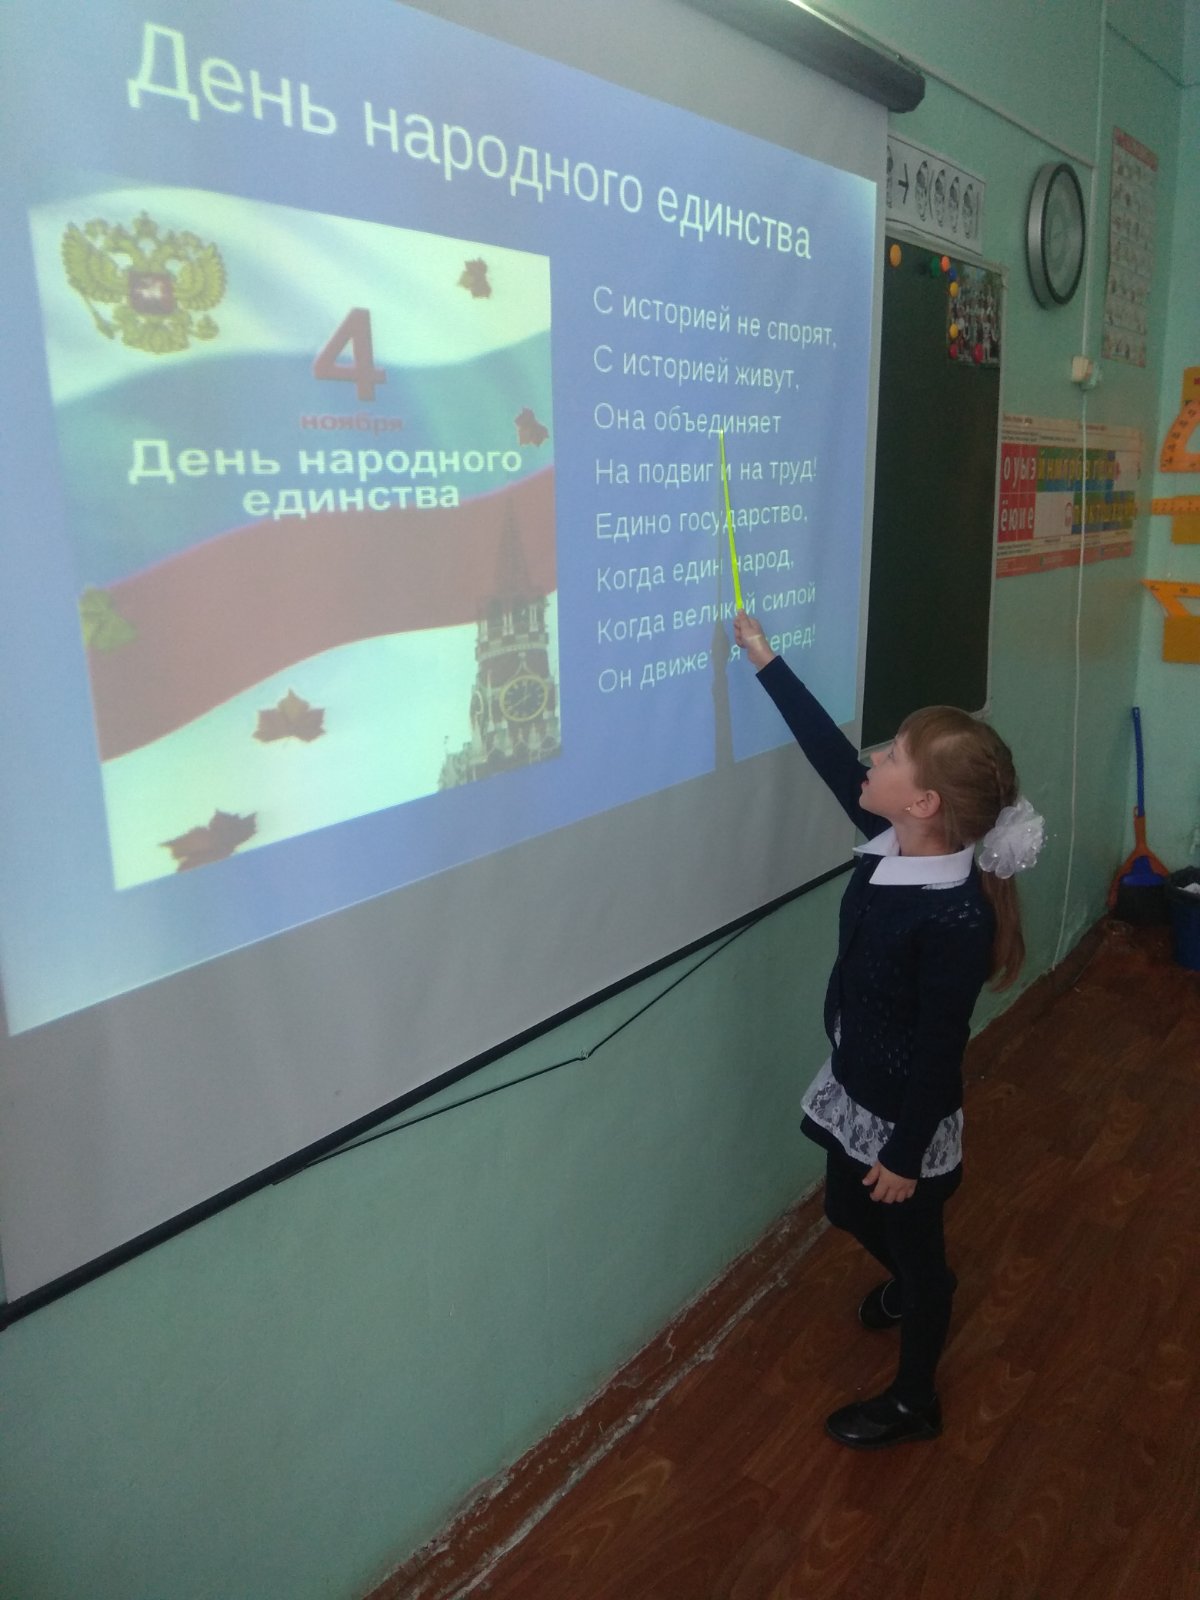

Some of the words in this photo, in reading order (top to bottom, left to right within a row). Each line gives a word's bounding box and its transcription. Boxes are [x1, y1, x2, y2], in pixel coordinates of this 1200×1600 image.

[127, 22, 338, 137] День
[364, 100, 644, 214] народного
[656, 186, 812, 260] единства
[594, 286, 613, 314] С
[623, 295, 730, 333] историей
[738, 315, 761, 336] не
[768, 320, 837, 349] спорят,
[312, 307, 386, 401] 4
[594, 345, 613, 373] С
[623, 352, 728, 386] историей
[735, 367, 800, 394] живут,
[301, 414, 403, 437] ноября
[594, 403, 646, 430] Она
[654, 405, 782, 439] объединяет
[128, 439, 281, 484] День
[299, 448, 522, 481] народного
[596, 459, 629, 485] На
[638, 462, 714, 488] подвиг
[720, 463, 732, 481] и
[740, 461, 763, 480] на
[769, 456, 817, 486] труд!
[242, 485, 460, 519] единства
[596, 512, 671, 542] Едино
[597, 565, 665, 592] Когда
[673, 557, 723, 584] един
[597, 616, 665, 644] Когда
[763, 581, 816, 612] силой
[599, 668, 632, 693] Он
